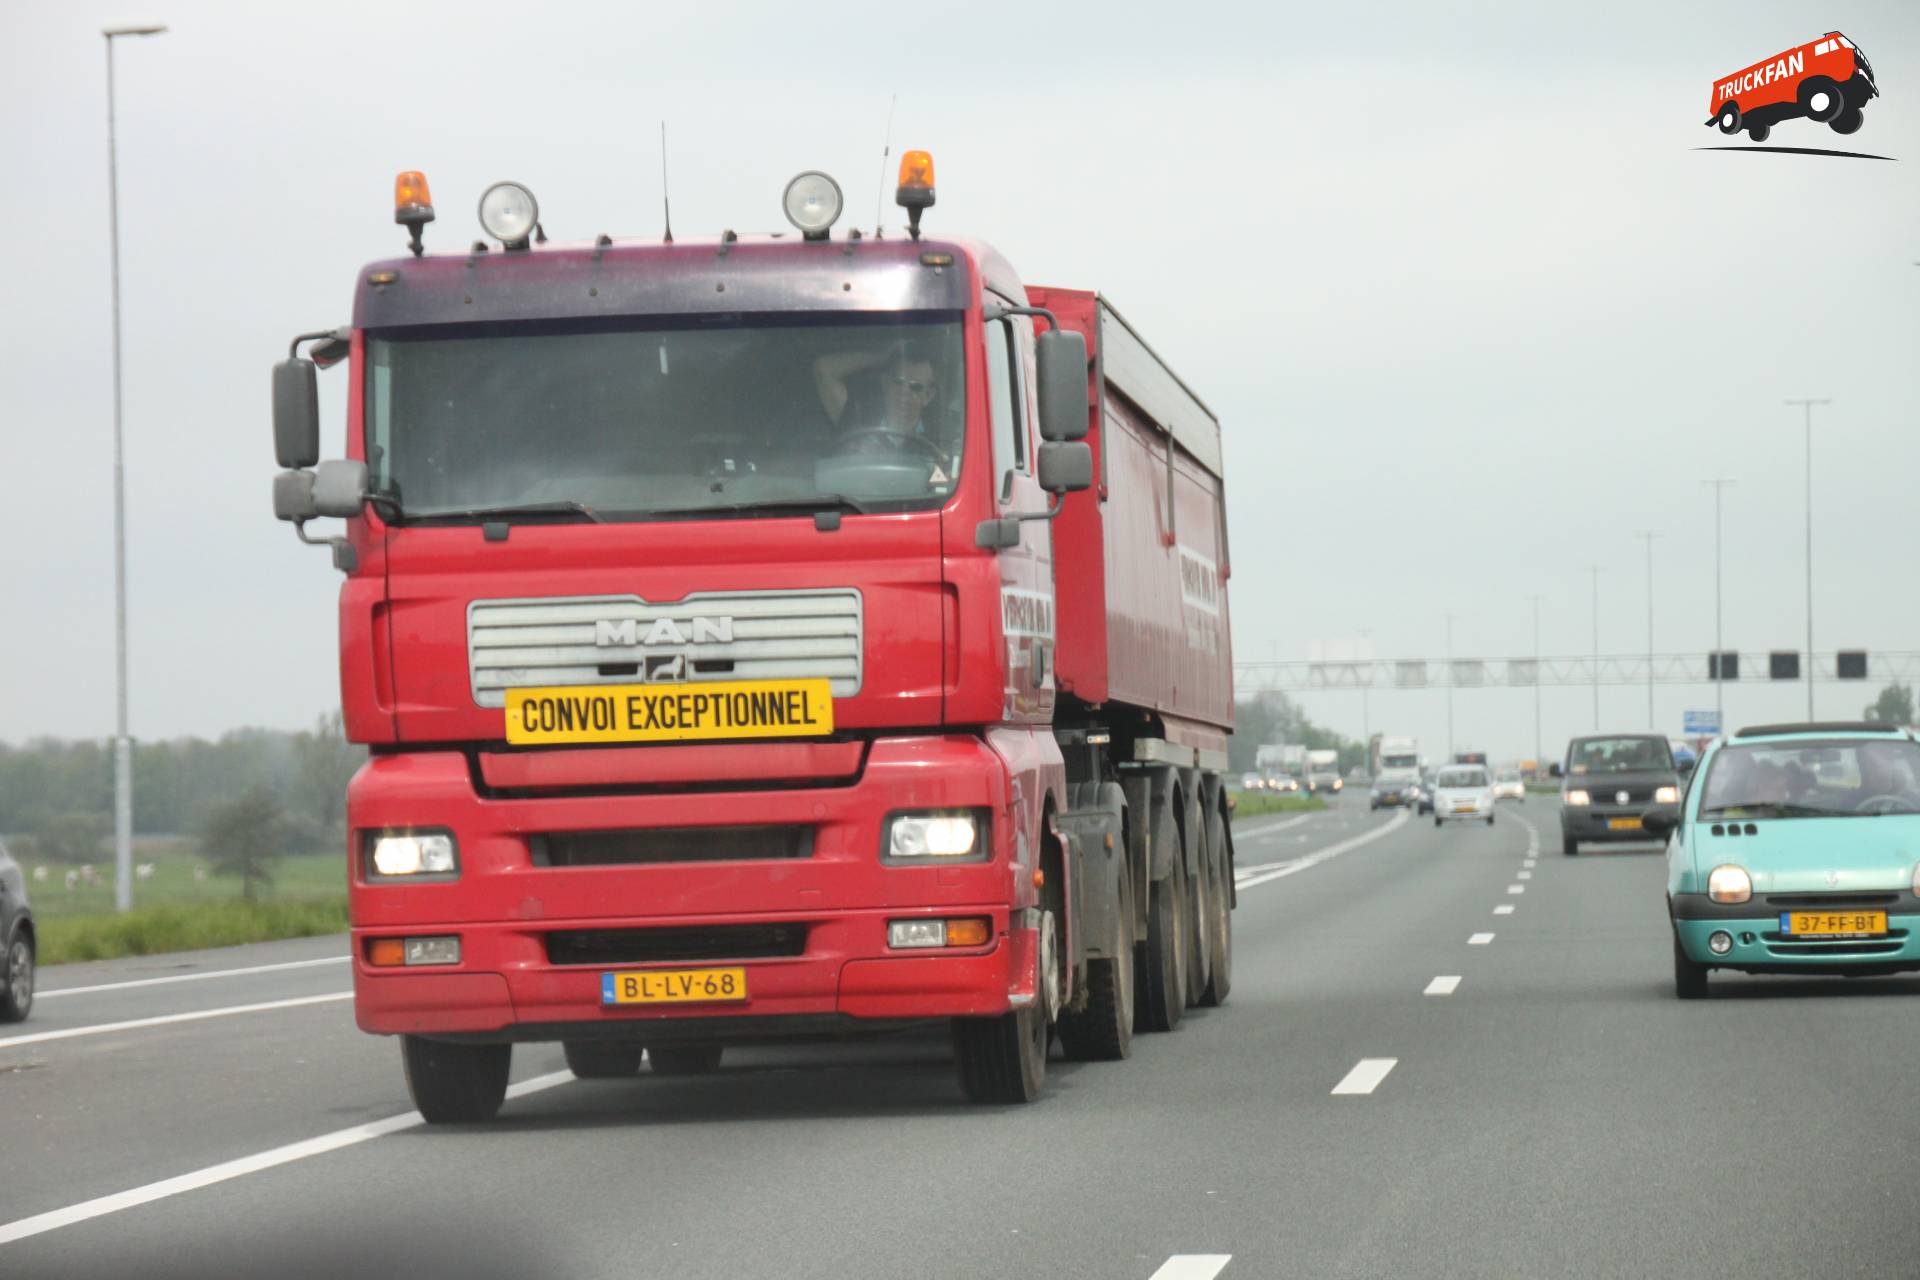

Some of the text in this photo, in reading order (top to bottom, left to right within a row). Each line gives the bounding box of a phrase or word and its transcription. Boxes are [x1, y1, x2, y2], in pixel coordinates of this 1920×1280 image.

[595, 616, 734, 646] MAN
[522, 690, 816, 732] CONVOI EXCEPTIONNEL
[624, 974, 735, 998] BL-LV-68
